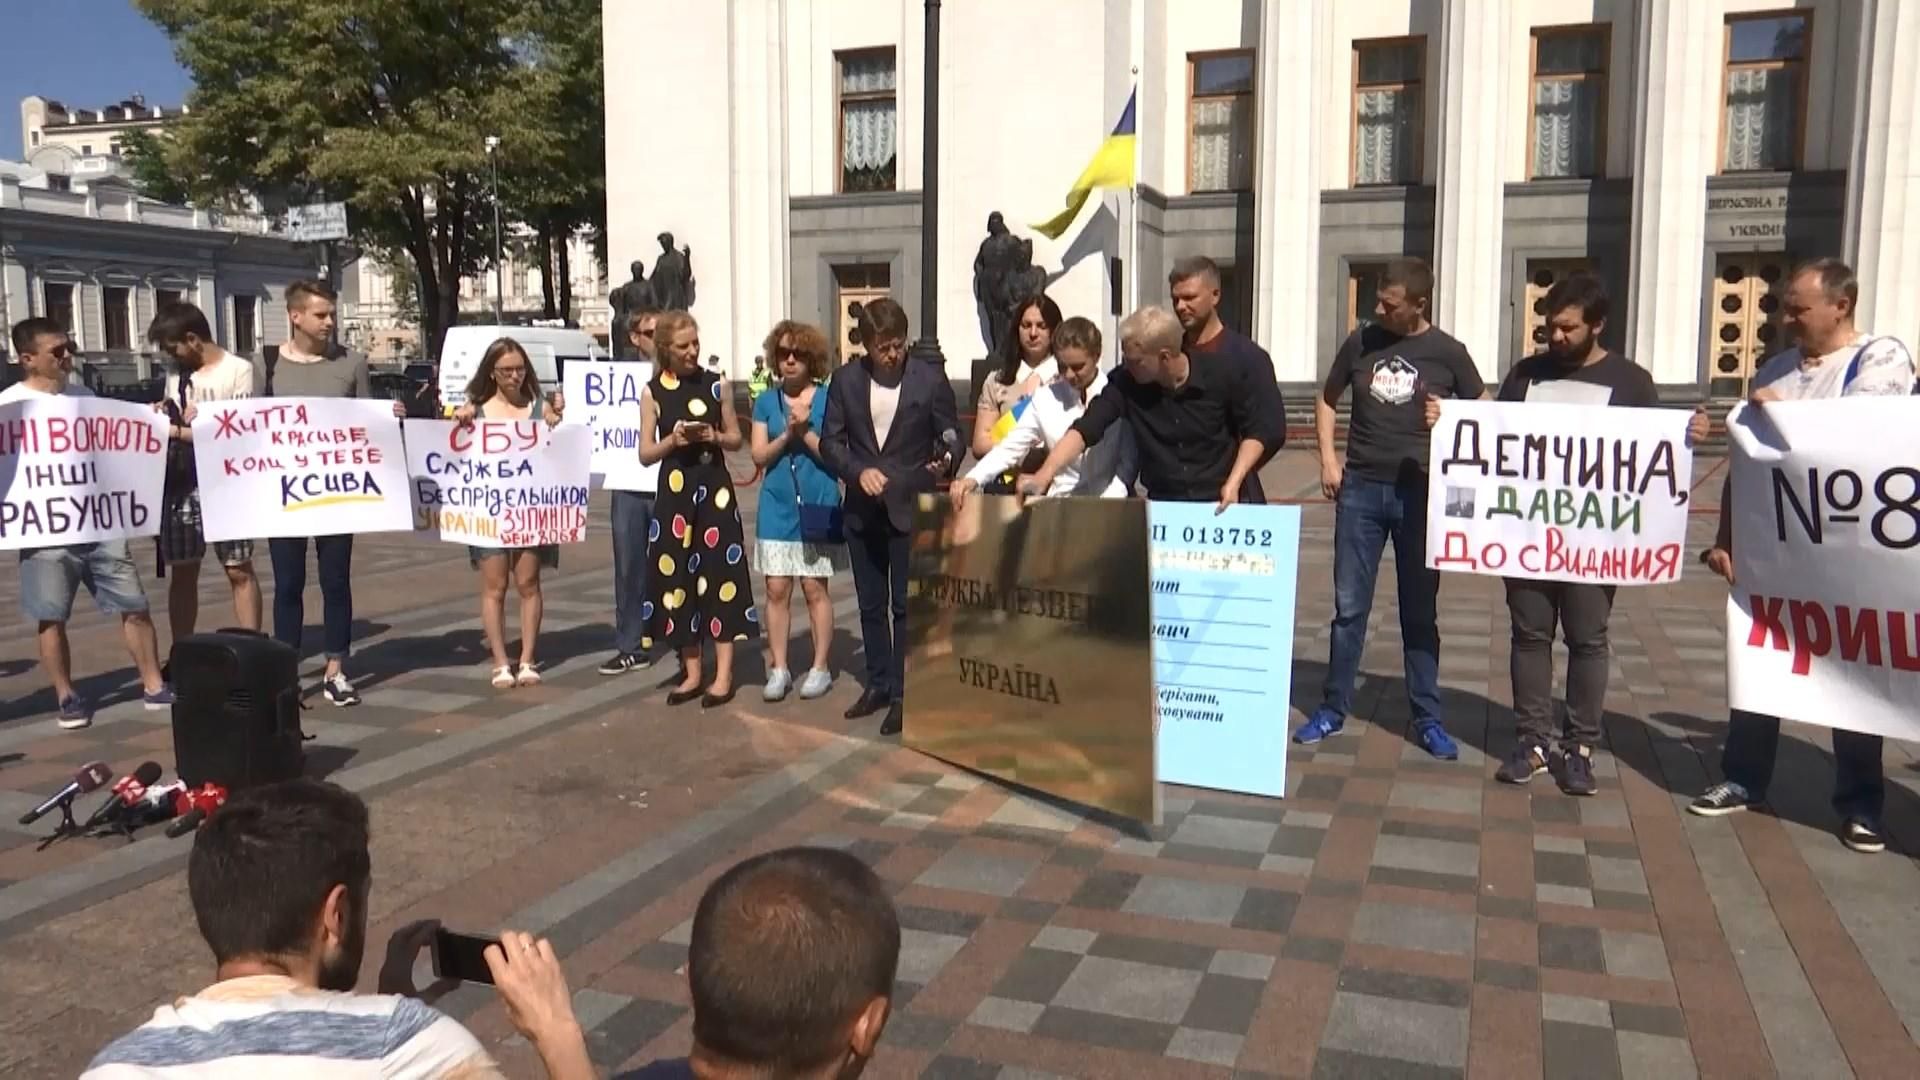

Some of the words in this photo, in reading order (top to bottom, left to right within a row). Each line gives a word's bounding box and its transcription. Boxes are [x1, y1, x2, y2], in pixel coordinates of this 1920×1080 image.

[1778, 196, 1788, 209] Р
[585, 366, 640, 408] ВІД
[48, 416, 161, 453] ВОЮЮТЬ
[214, 403, 309, 440] ЖИТТЯ
[26, 461, 97, 489] ІНШІ
[224, 456, 285, 476] КОЛИ
[295, 454, 308, 467] У
[317, 448, 382, 466] ТЕБЕ
[1442, 419, 1689, 506] ДЕМЧИНА,
[281, 470, 382, 506] КСИВА
[1486, 486, 1641, 535] ДАВАЙ
[1182, 526, 1273, 547] 013752
[960, 657, 1060, 704] УКРАЇНА
